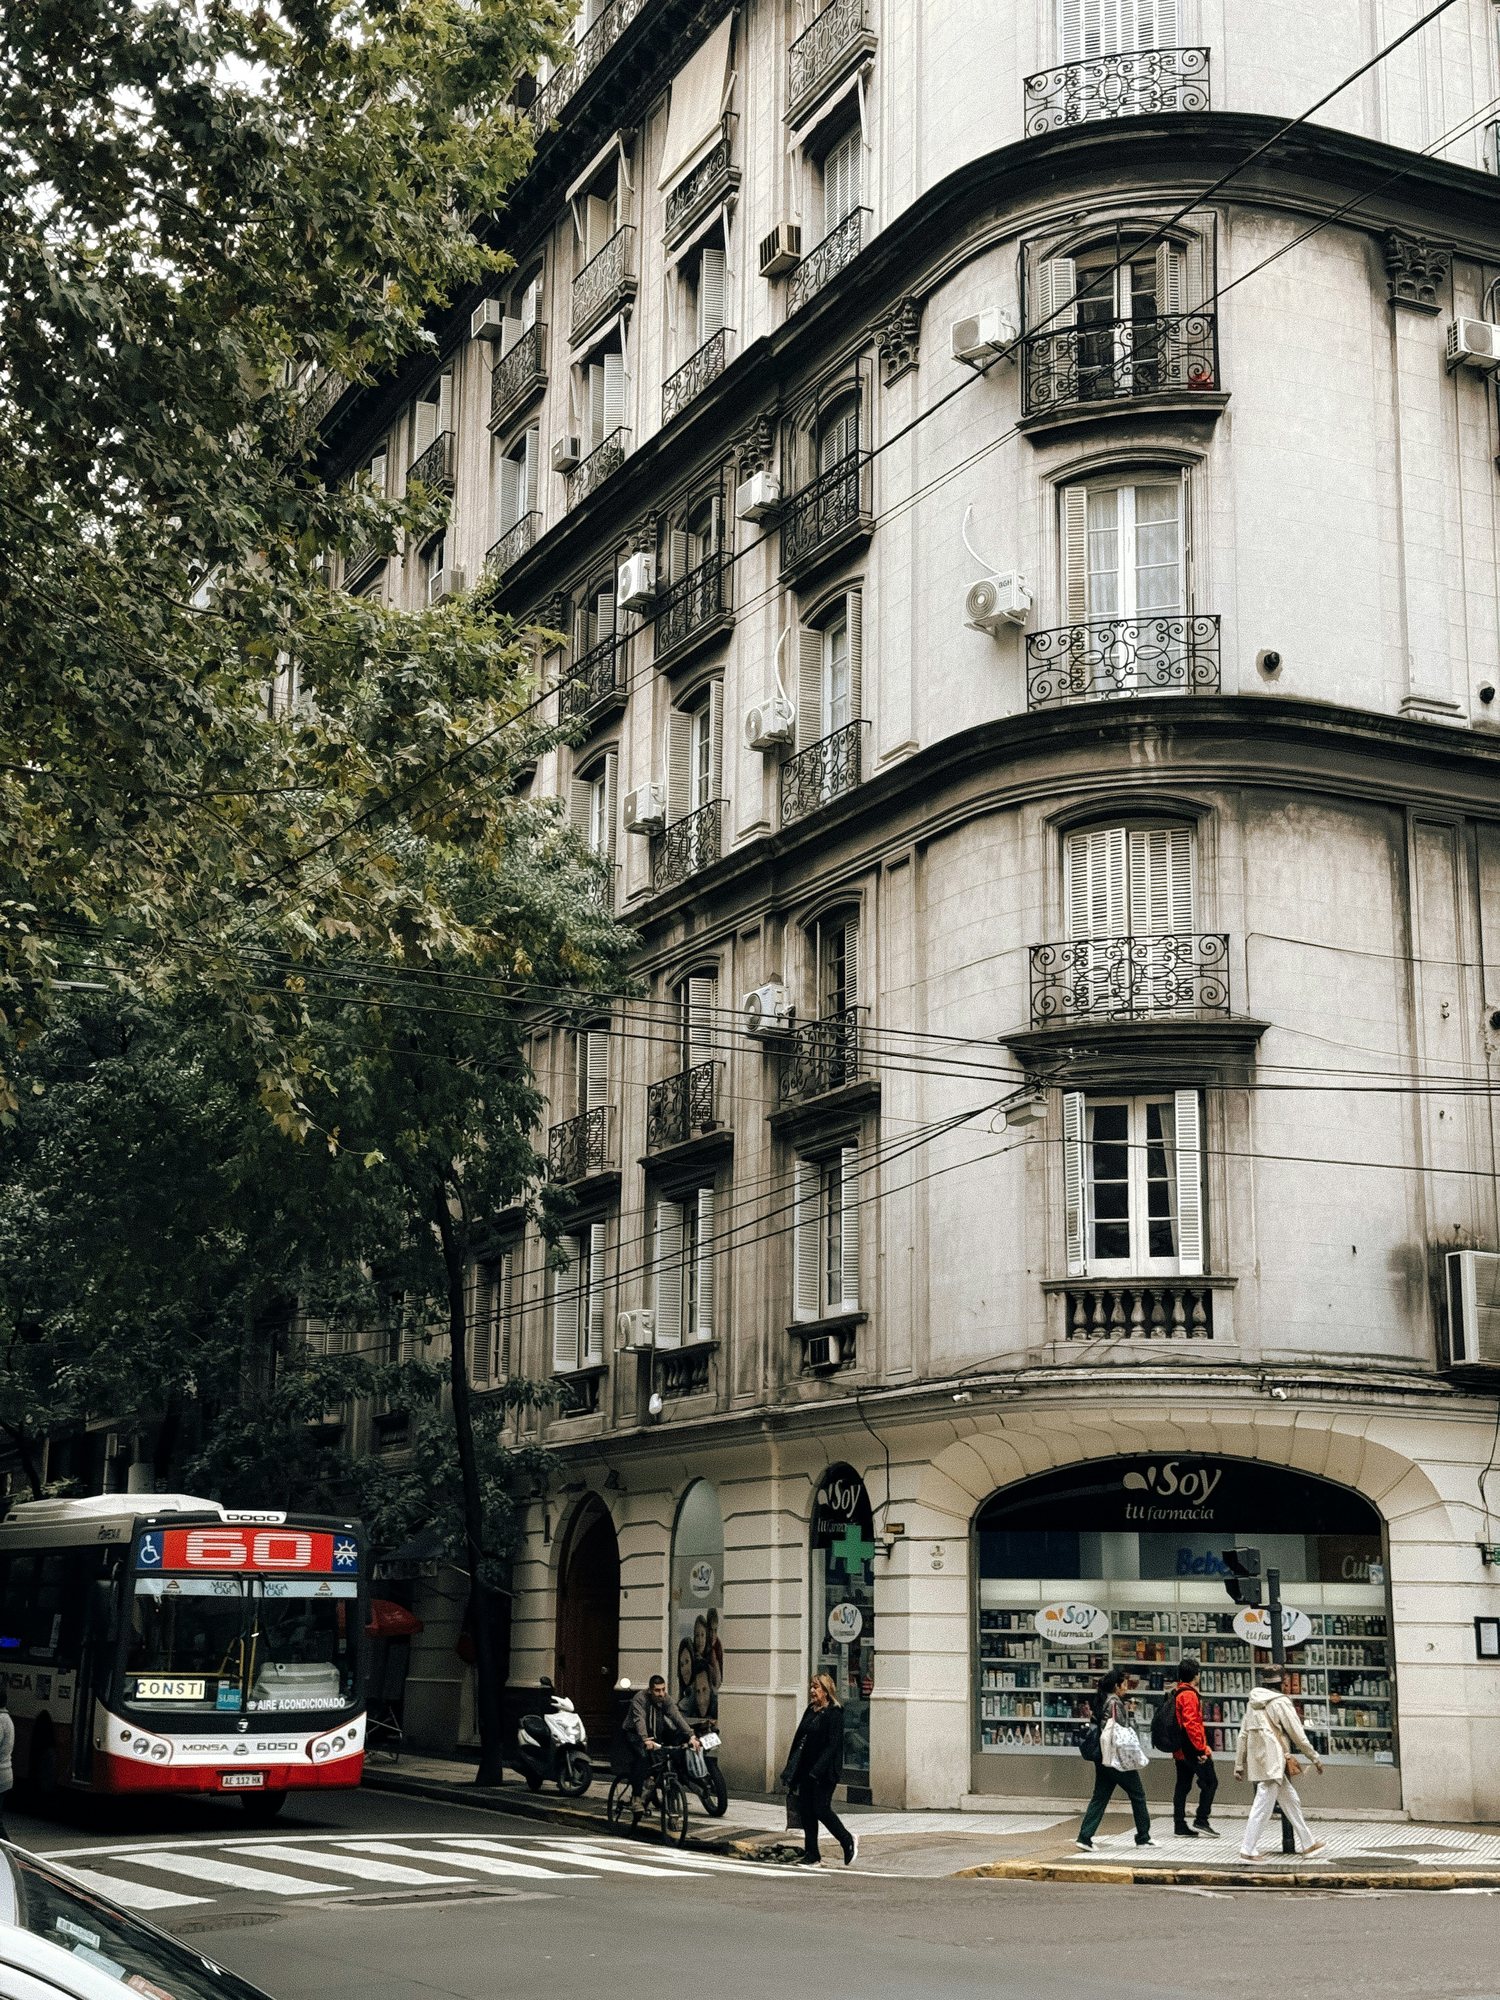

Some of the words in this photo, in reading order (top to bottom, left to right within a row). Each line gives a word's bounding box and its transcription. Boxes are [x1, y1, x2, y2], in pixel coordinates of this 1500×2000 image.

[1156, 1461, 1222, 1506] Soy
[831, 1479, 861, 1519] Soy
[1124, 1503, 1145, 1520] tu
[1147, 1505, 1214, 1521] farmacia
[185, 1531, 313, 1567] 60
[1063, 1605, 1098, 1630] Soy
[137, 1682, 203, 1695] CONSTI
[257, 1699, 277, 1711] AIRE
[278, 1697, 346, 1710] ACONDICIONADO
[181, 1743, 229, 1751] MONSA
[256, 1742, 298, 1751] 6050
